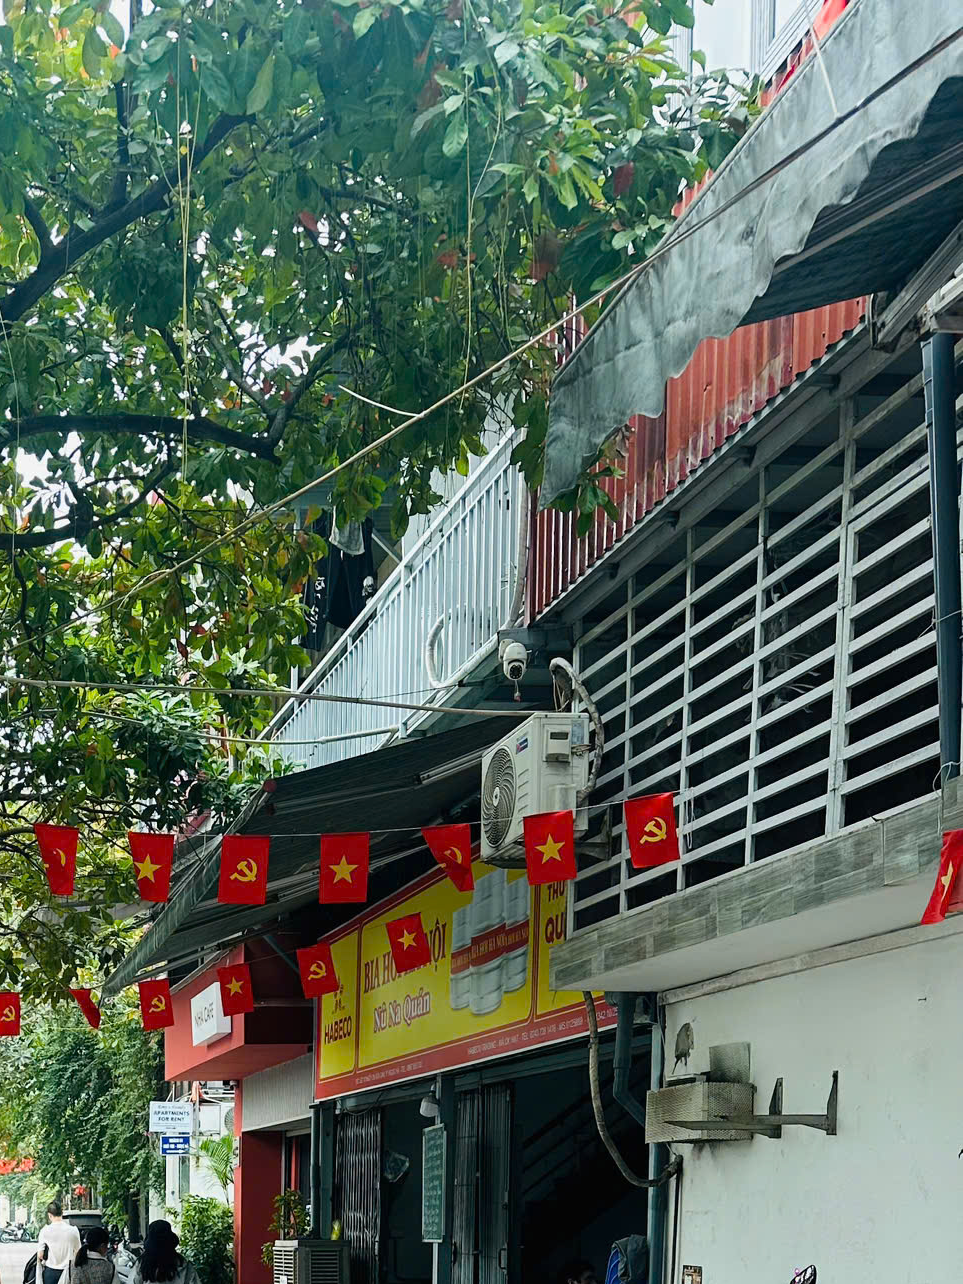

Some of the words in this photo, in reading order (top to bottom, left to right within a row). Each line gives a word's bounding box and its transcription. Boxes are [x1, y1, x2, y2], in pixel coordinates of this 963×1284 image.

[545, 911, 565, 944] QU
[364, 957, 380, 994] BIA
[388, 1000, 401, 1028] Na
[403, 987, 430, 1026] Quán
[325, 1015, 352, 1045] HABECO
